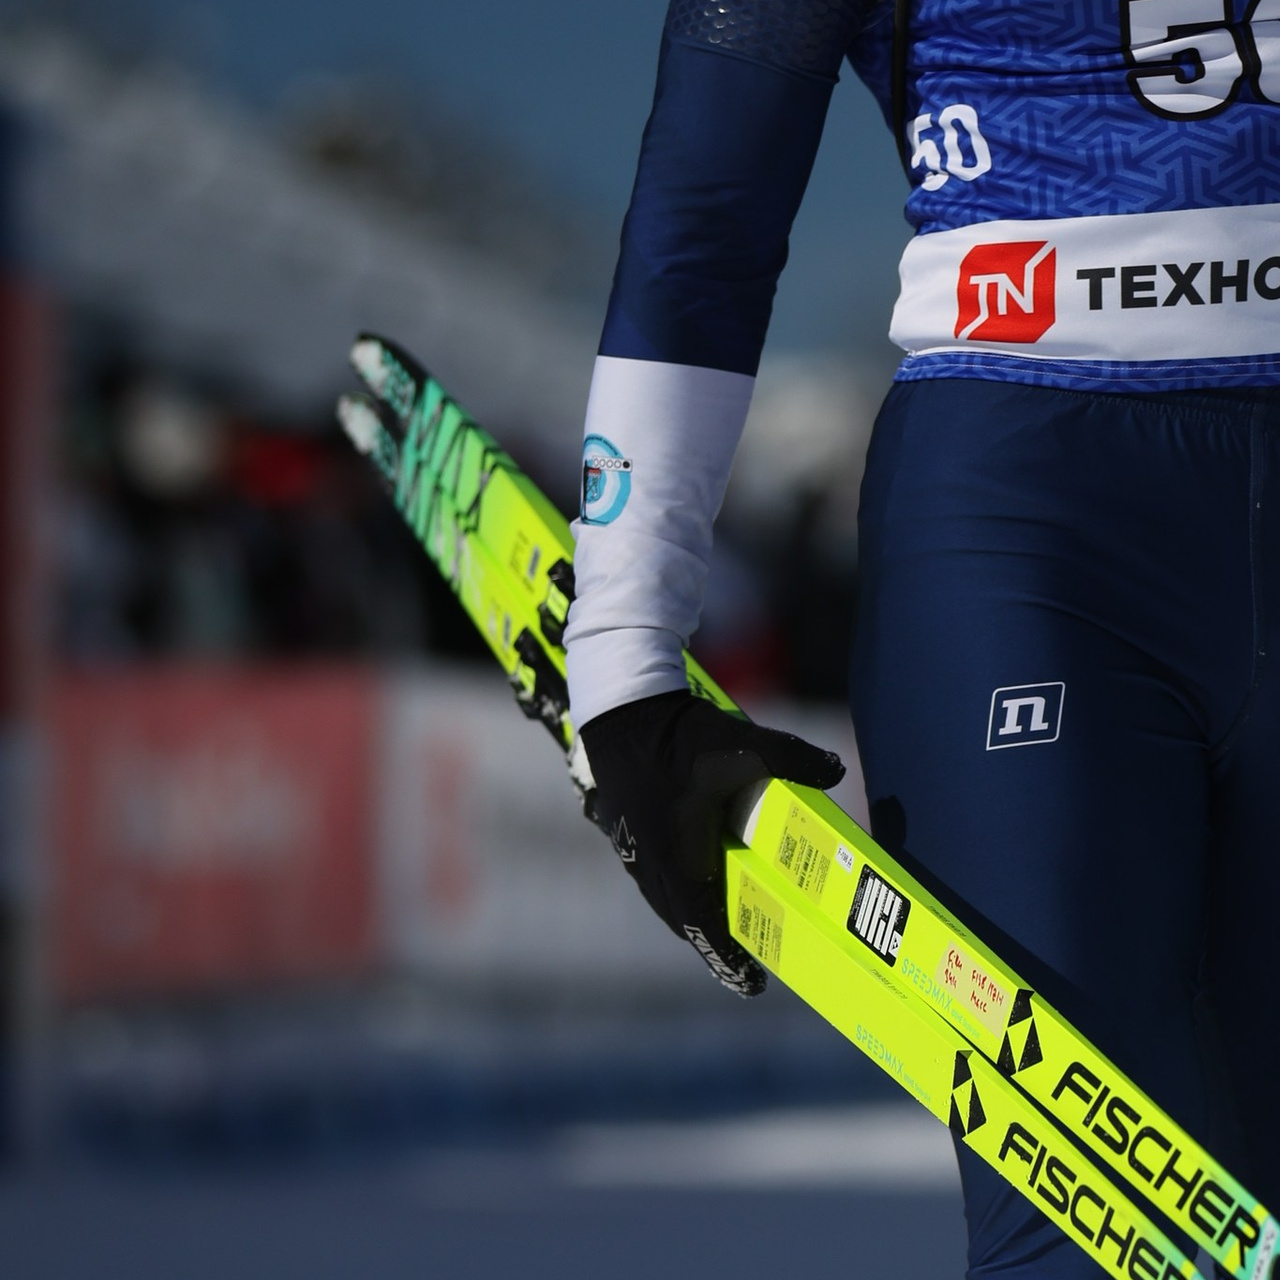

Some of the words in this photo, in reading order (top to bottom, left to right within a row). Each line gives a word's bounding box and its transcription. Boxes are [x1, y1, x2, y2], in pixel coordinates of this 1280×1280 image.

[907, 104, 992, 192] 50
[901, 957, 953, 1014] SPEEDMAX
[1050, 1061, 1261, 1271] FISCHER
